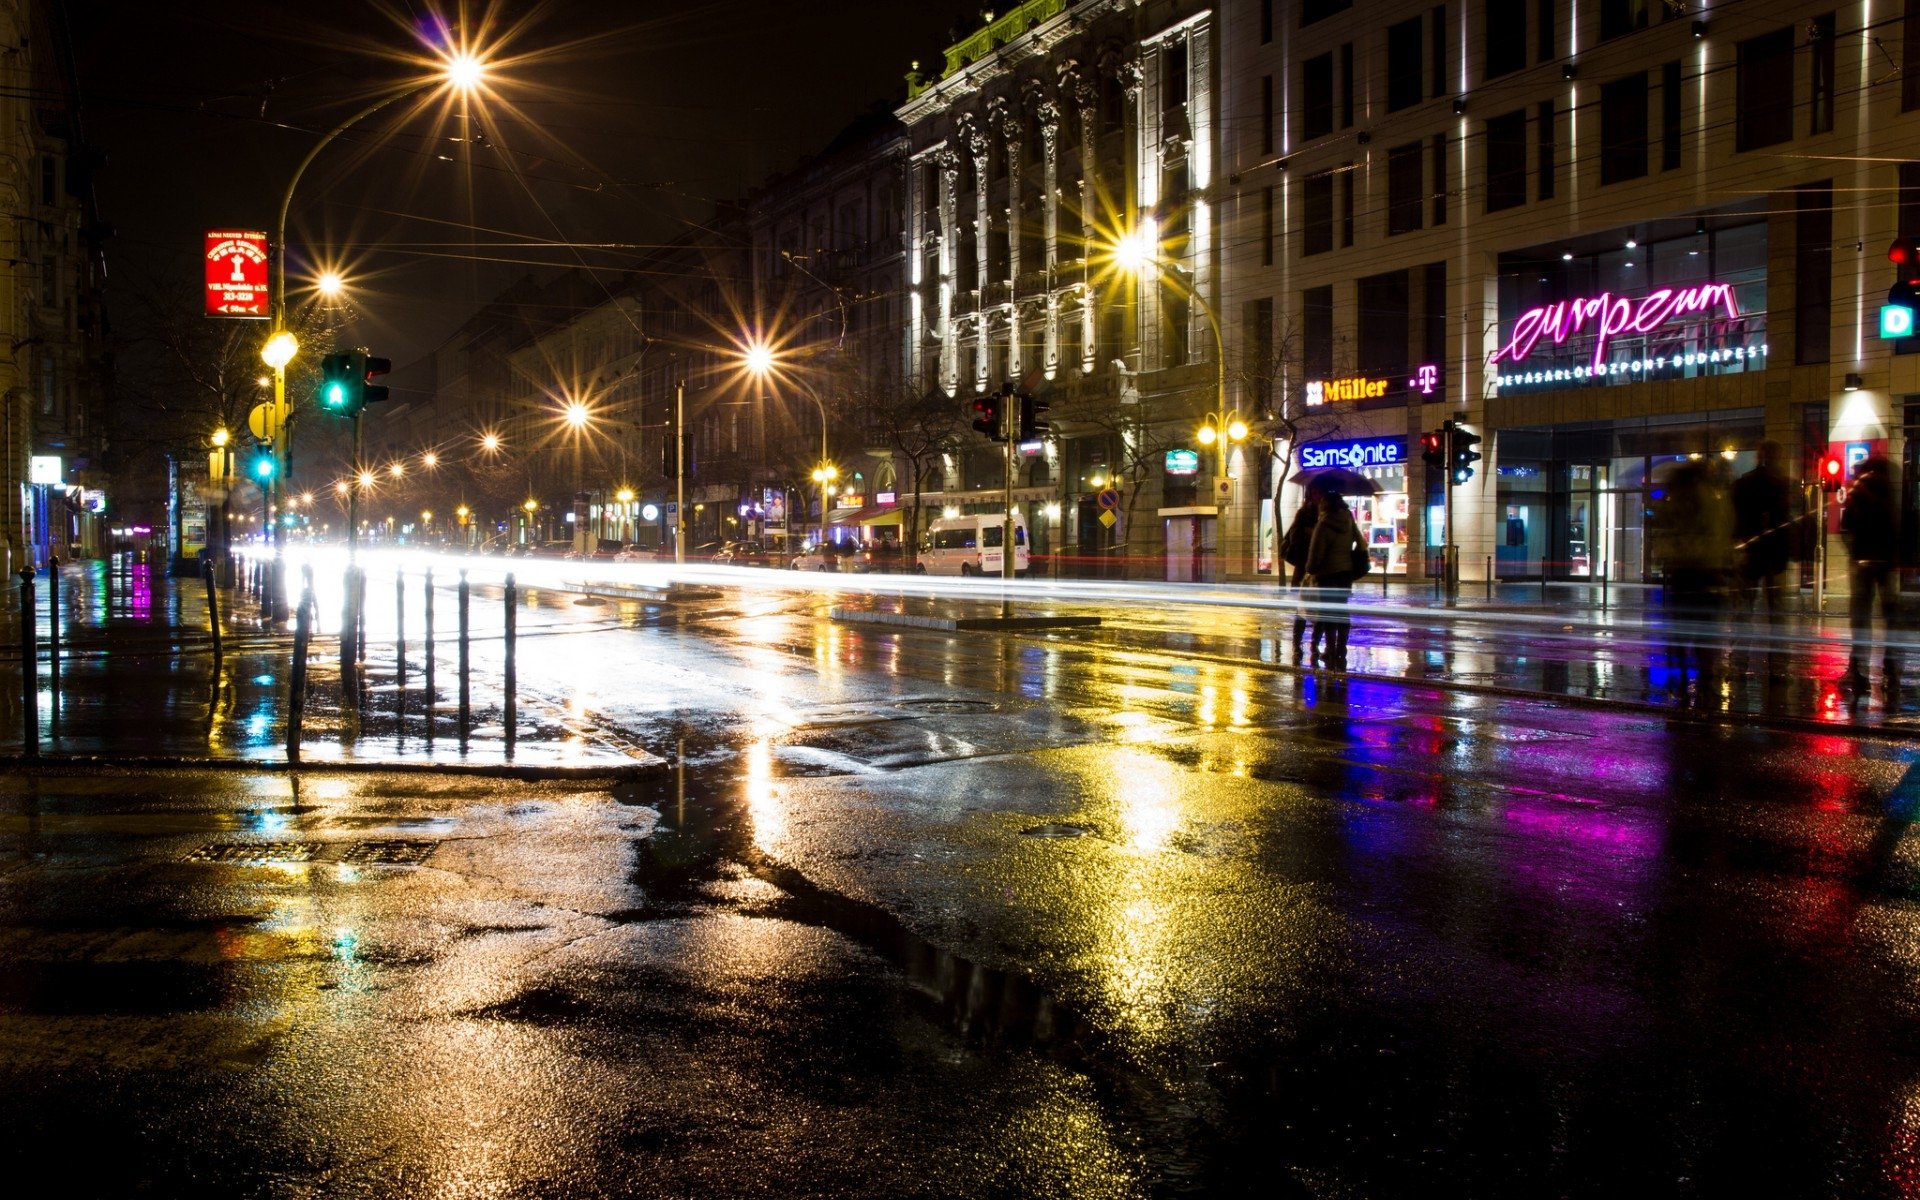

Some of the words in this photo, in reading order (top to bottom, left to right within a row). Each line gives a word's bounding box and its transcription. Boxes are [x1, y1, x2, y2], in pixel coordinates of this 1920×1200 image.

[1491, 283, 1740, 374] europeum
[1885, 308, 1910, 333] D
[1674, 344, 1769, 368] BUDAPEST
[1323, 377, 1388, 402] Müller
[1302, 442, 1397, 467] Samsonite
[1848, 447, 1869, 476] P
